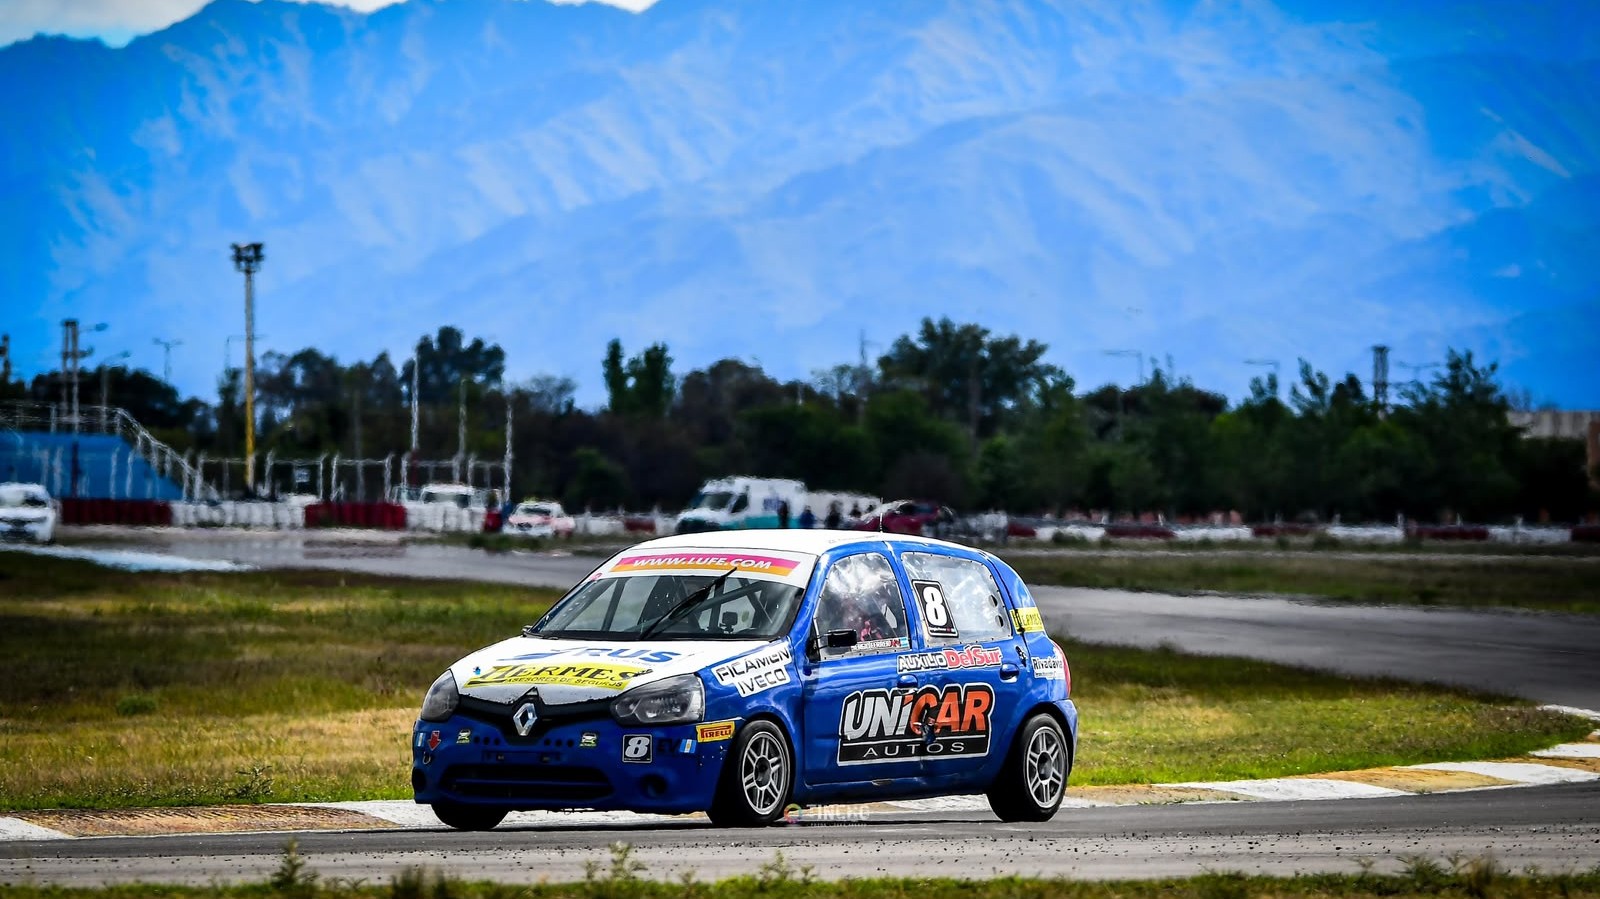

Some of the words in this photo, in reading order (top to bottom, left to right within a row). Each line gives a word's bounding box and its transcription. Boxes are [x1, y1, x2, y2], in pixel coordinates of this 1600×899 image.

[633, 557, 772, 569] WWW.LUFE.COM
[923, 586, 948, 626] 8
[899, 653, 947, 673] AUXILIO
[737, 668, 787, 695] IVECO
[700, 724, 732, 739] PIRELLI
[624, 736, 650, 758] 8
[863, 741, 965, 758] AUTOS
